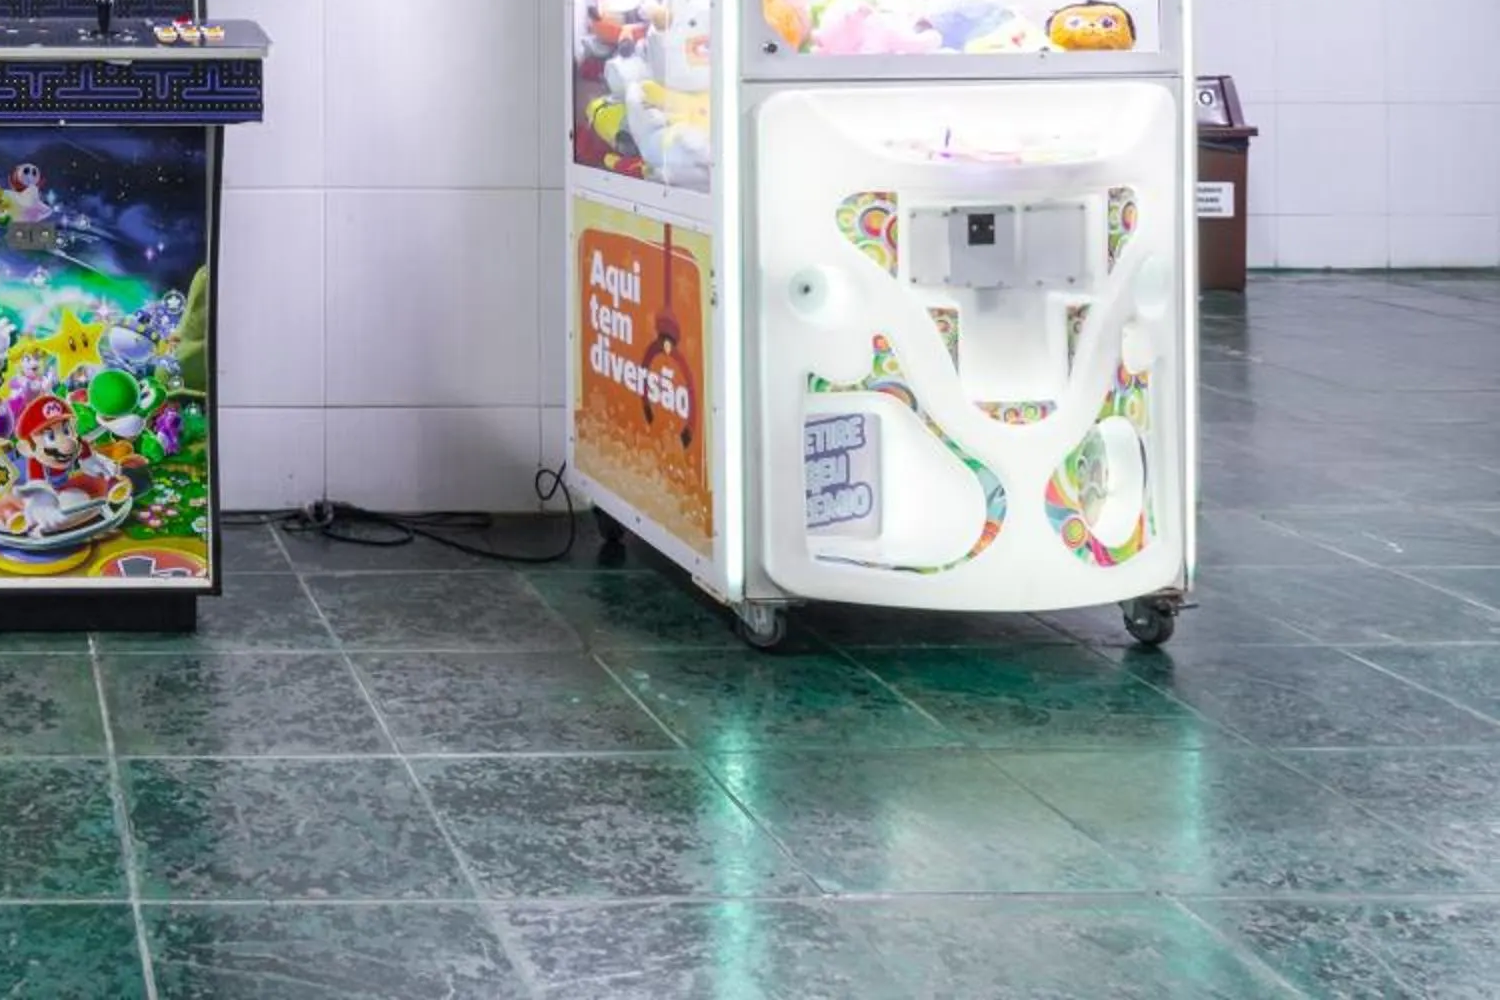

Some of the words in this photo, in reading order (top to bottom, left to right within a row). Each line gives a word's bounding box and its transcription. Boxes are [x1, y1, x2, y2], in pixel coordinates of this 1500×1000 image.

[589, 249, 642, 307] Aqui
[589, 293, 633, 345] tem
[589, 335, 690, 420] diversão
